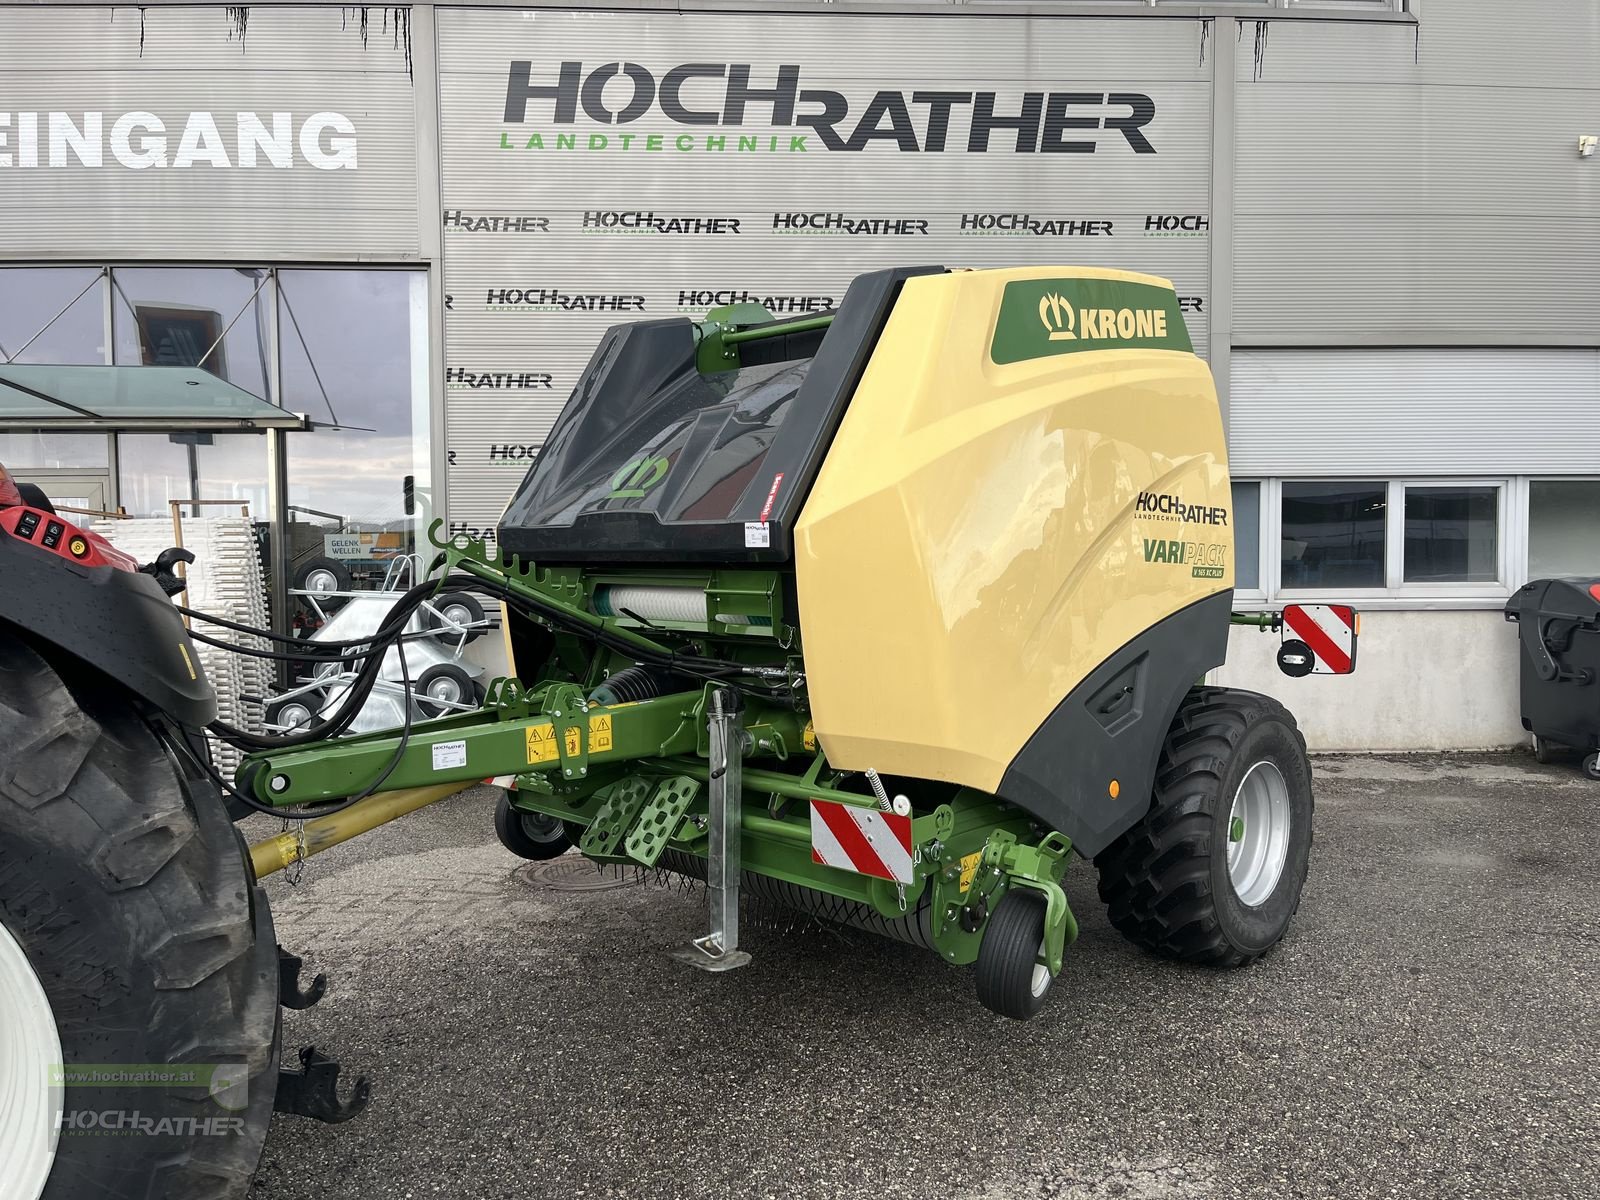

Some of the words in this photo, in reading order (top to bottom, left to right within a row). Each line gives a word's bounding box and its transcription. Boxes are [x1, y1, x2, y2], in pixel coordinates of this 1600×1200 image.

[503, 60, 1158, 154] HOCHRATHER
[500, 132, 809, 152] LANDTECHNIK
[583, 211, 742, 235] HOCHRATHER
[773, 213, 929, 235] HOCHRATHER
[960, 214, 1114, 237] HOCHRATHER
[487, 289, 647, 311] HOCHRATHER
[1080, 308, 1168, 339] KRONE
[1134, 513, 1181, 522] LANDTECHNIK
[1135, 491, 1228, 527] HOCHRATHER
[332, 547, 361, 555] WELLEN
[1143, 538, 1227, 567] VARIPACK
[1198, 568, 1206, 577] 165
[1212, 569, 1223, 577] PLUS
